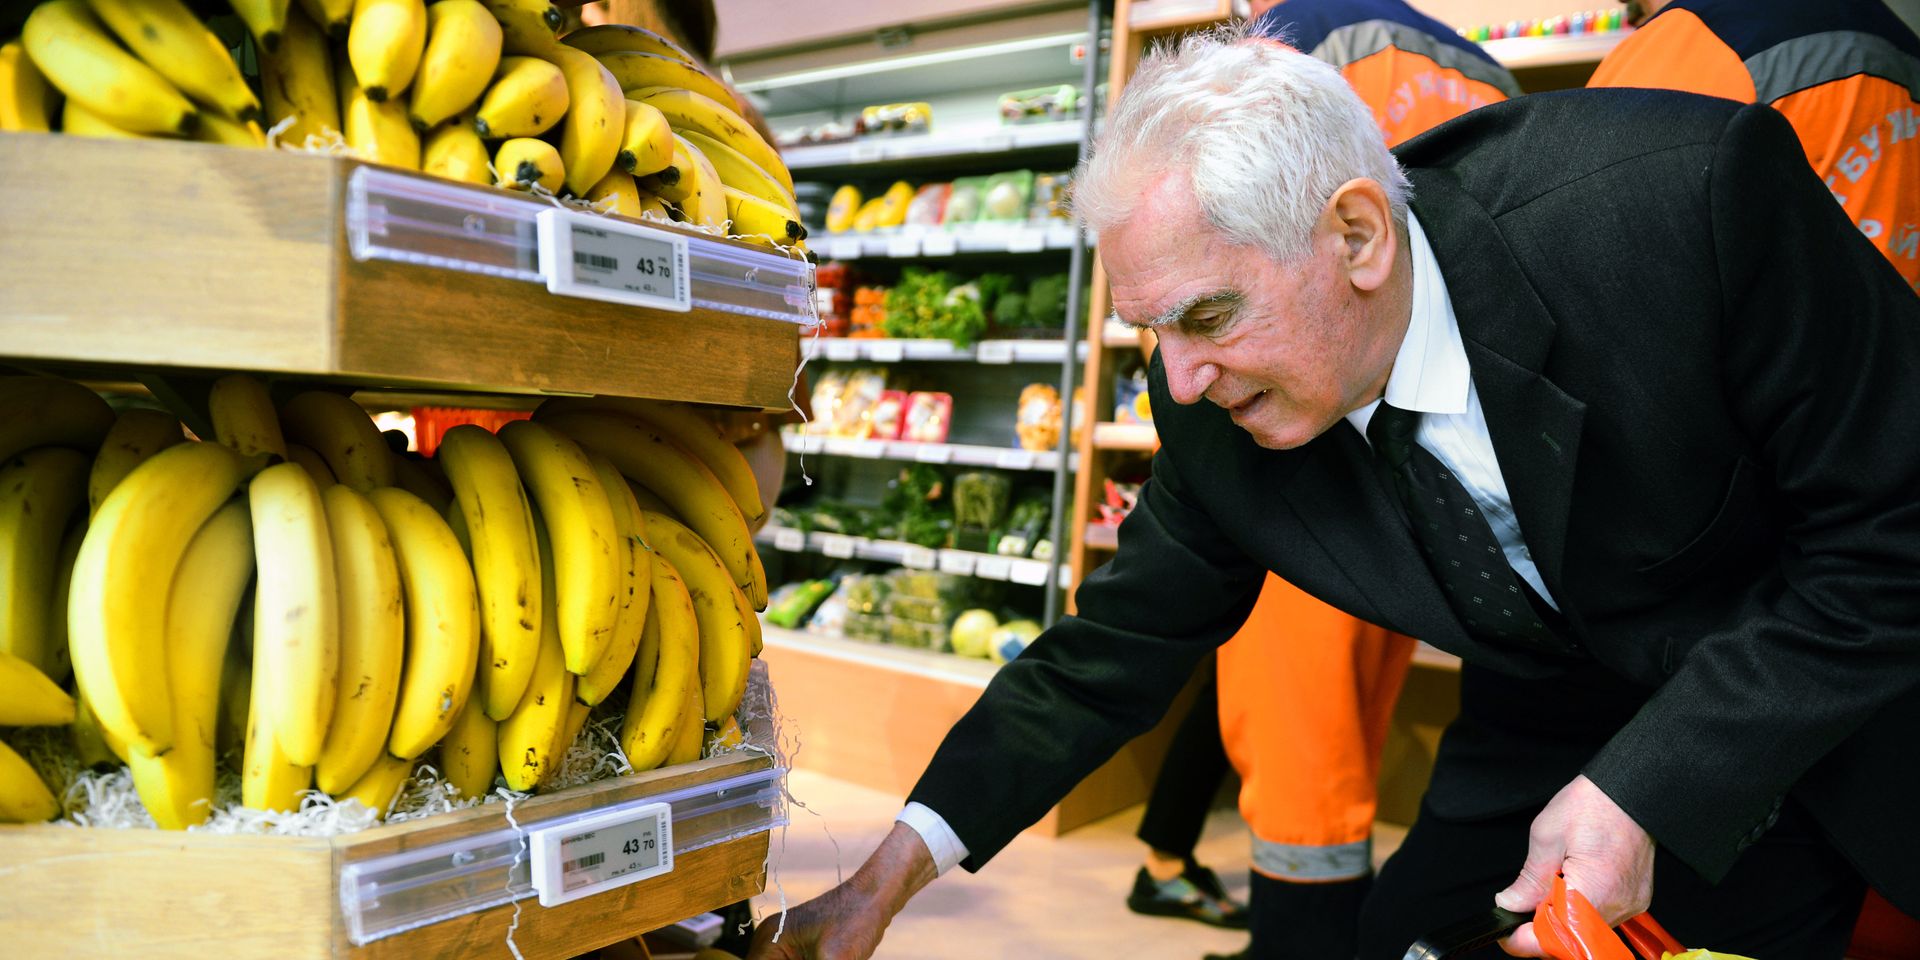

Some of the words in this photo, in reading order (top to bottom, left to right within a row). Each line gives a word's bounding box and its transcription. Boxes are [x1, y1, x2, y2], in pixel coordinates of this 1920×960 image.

[637, 257, 655, 275] 43
[658, 265, 671, 278] 70
[623, 838, 640, 855] 43
[643, 839, 655, 851] 70
